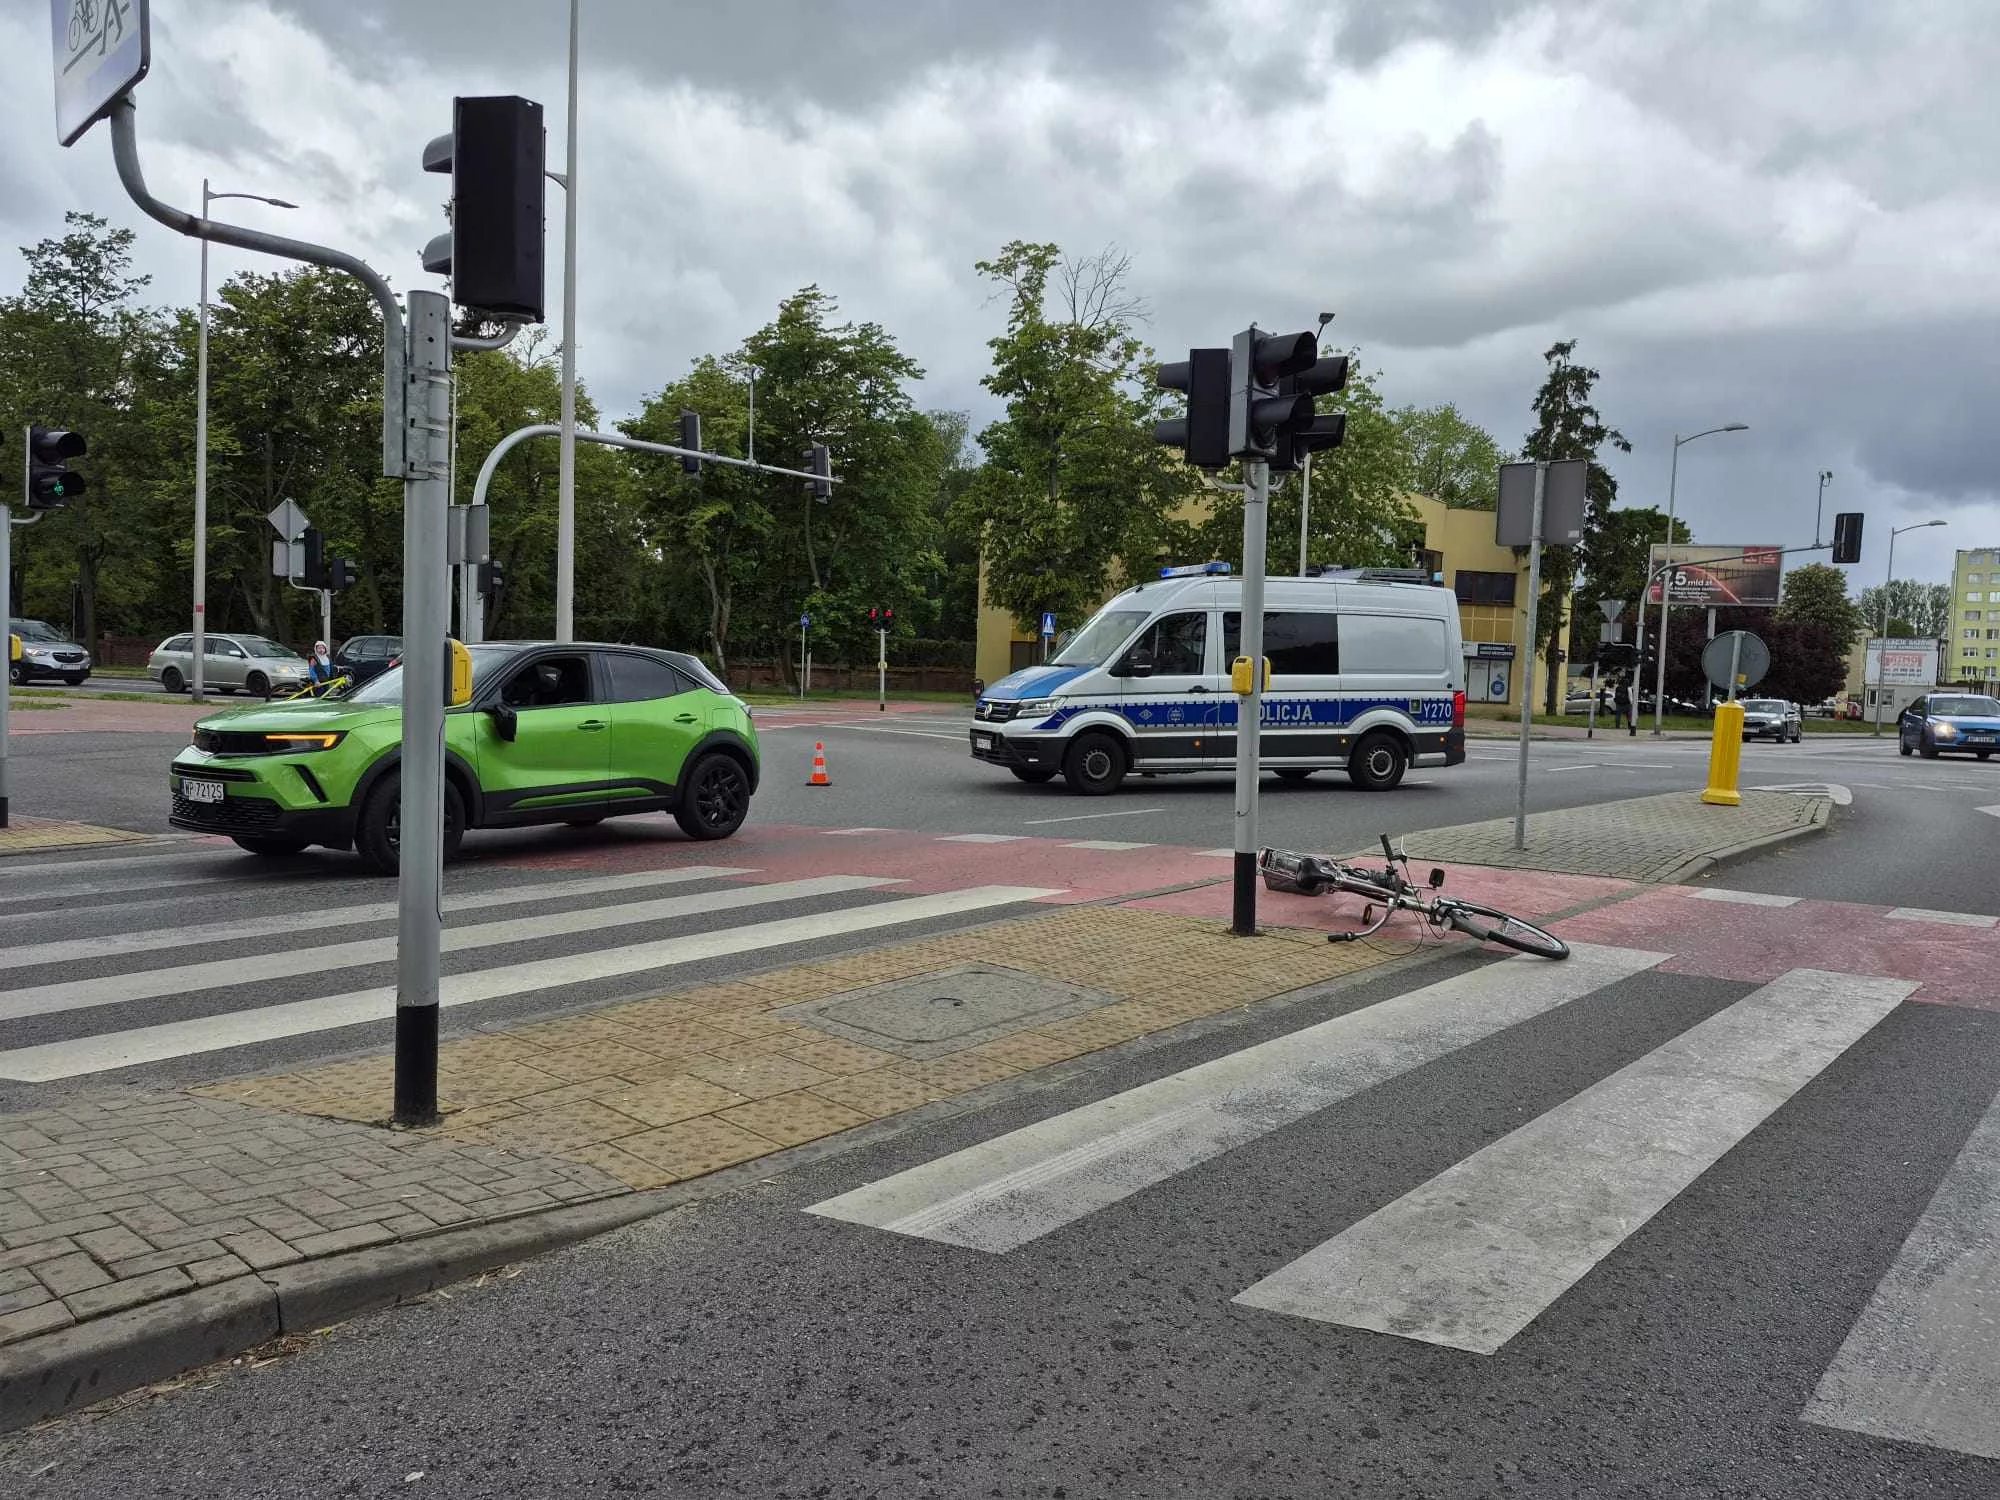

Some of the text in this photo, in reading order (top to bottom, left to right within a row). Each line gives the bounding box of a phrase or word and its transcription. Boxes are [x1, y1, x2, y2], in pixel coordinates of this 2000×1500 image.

[1259, 704, 1313, 721] OLICJA
[1423, 703, 1452, 719] Y270
[185, 781, 223, 799] WP 7212S
